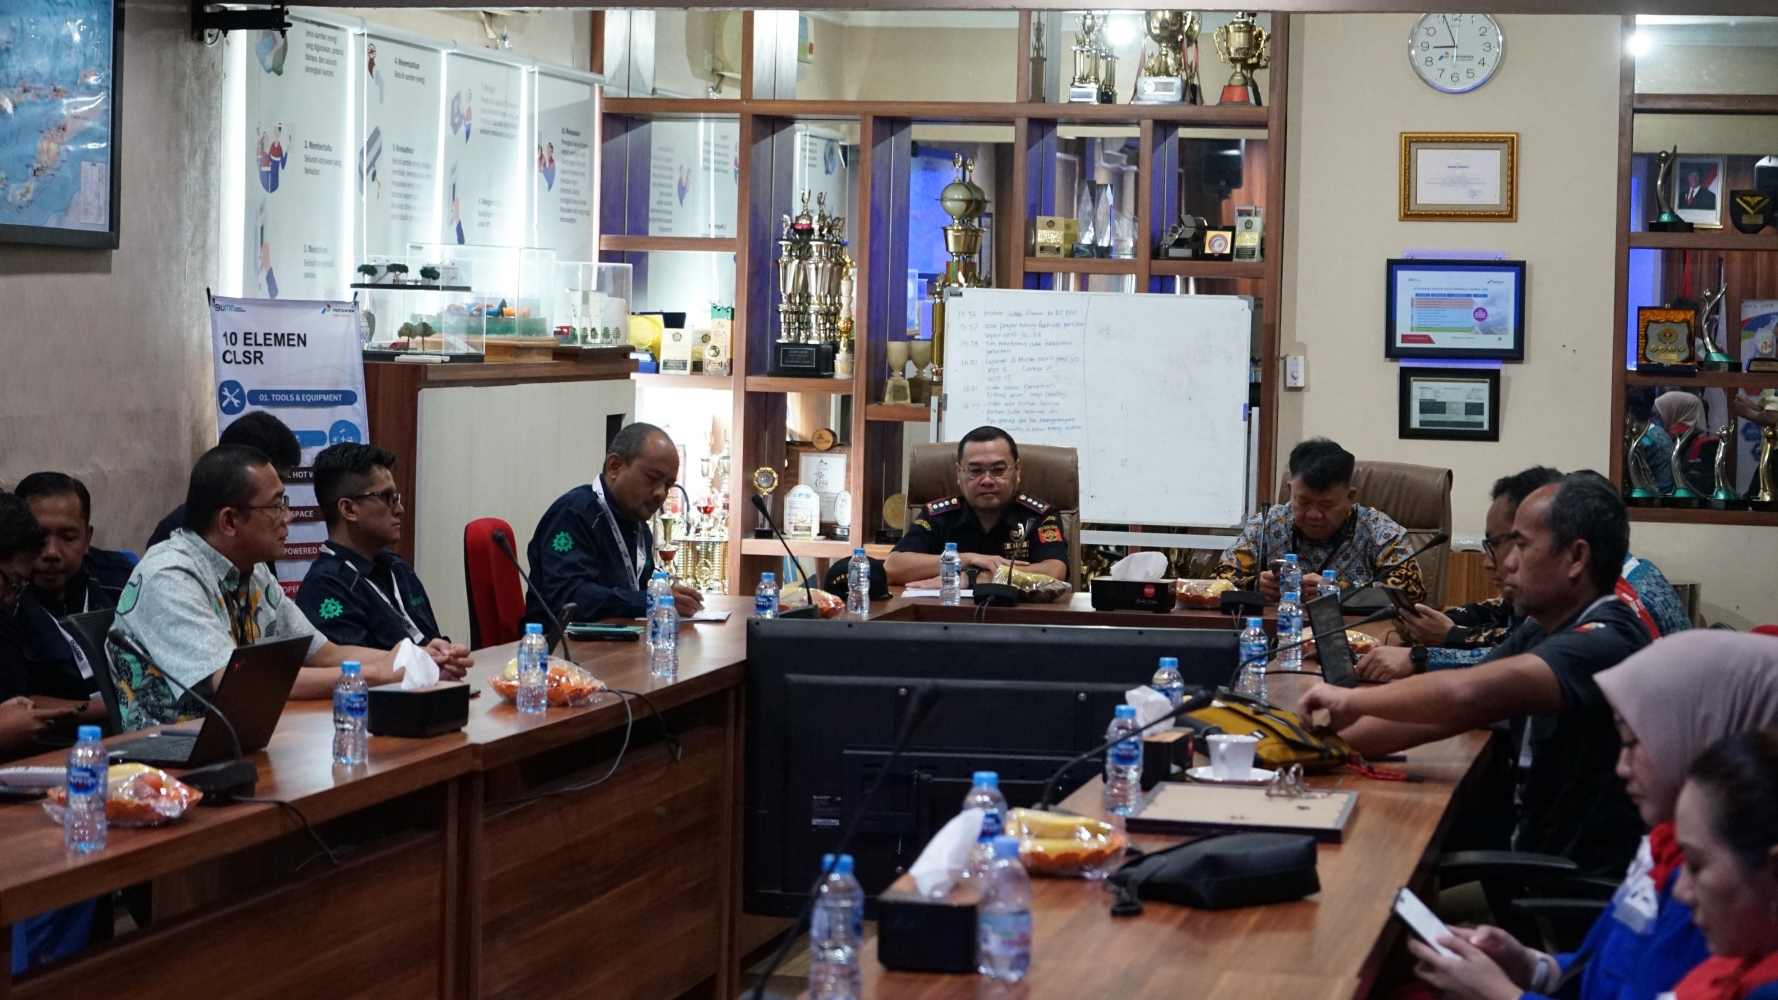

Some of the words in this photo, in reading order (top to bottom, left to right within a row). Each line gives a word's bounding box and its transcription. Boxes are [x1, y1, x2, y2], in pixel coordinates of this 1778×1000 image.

[1479, 26, 1488, 37] 2
[1420, 41, 1430, 52] 9
[1483, 42, 1492, 52] 3
[1424, 56, 1434, 67] 8
[1477, 57, 1486, 67] 4
[1437, 68, 1445, 78] 7
[1466, 68, 1475, 79] 5
[1450, 72, 1460, 83] 6
[223, 332, 237, 346] 10
[243, 332, 307, 347] ELEMEN
[222, 350, 264, 365] CLSR
[259, 394, 270, 402] 01.
[271, 394, 295, 402] TOOLS
[295, 394, 301, 402] &
[302, 394, 343, 402] EQUIPMENT
[293, 471, 307, 479] HOT
[291, 510, 314, 518] SPACE
[284, 546, 318, 555] POWERED
